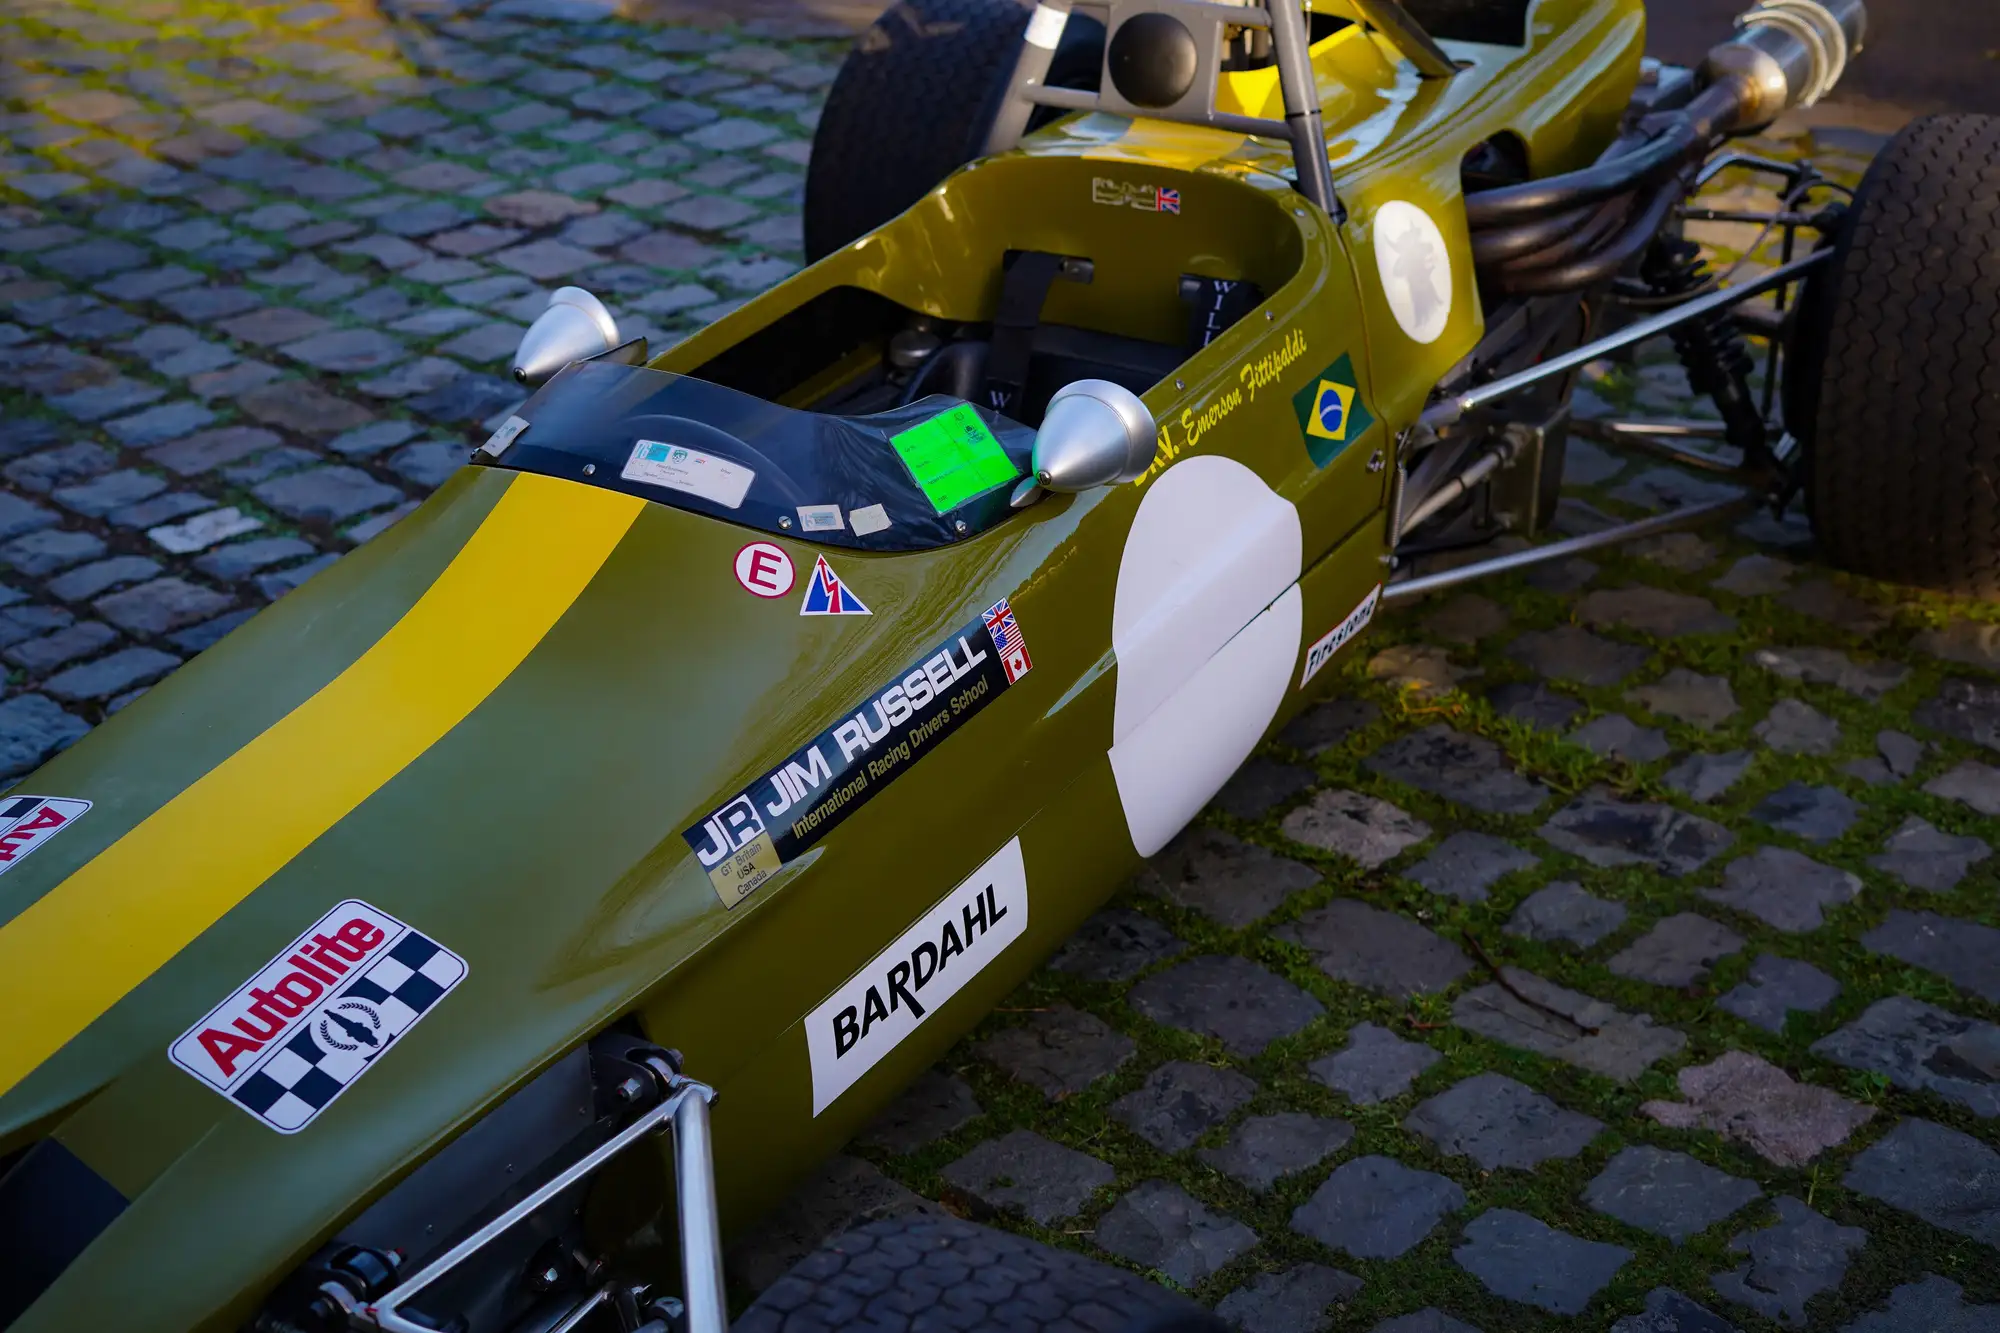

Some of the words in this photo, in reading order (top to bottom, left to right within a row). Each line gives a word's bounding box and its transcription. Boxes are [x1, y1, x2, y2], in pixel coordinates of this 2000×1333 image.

[1181, 388, 1243, 447] Emerson
[1240, 328, 1307, 402] Fittipaldi
[748, 549, 782, 590] E
[766, 745, 833, 817] JIM
[832, 636, 988, 763] RUSSELL
[791, 770, 868, 839] International
[868, 739, 911, 781] Racing
[909, 708, 950, 749] Drivers
[950, 674, 989, 716] School
[697, 794, 766, 866] JR
[735, 842, 762, 866] Britain
[736, 862, 756, 880] USA
[737, 869, 767, 895] Canada
[196, 918, 385, 1078] Autolite
[832, 883, 1008, 1060] BARDAHL
